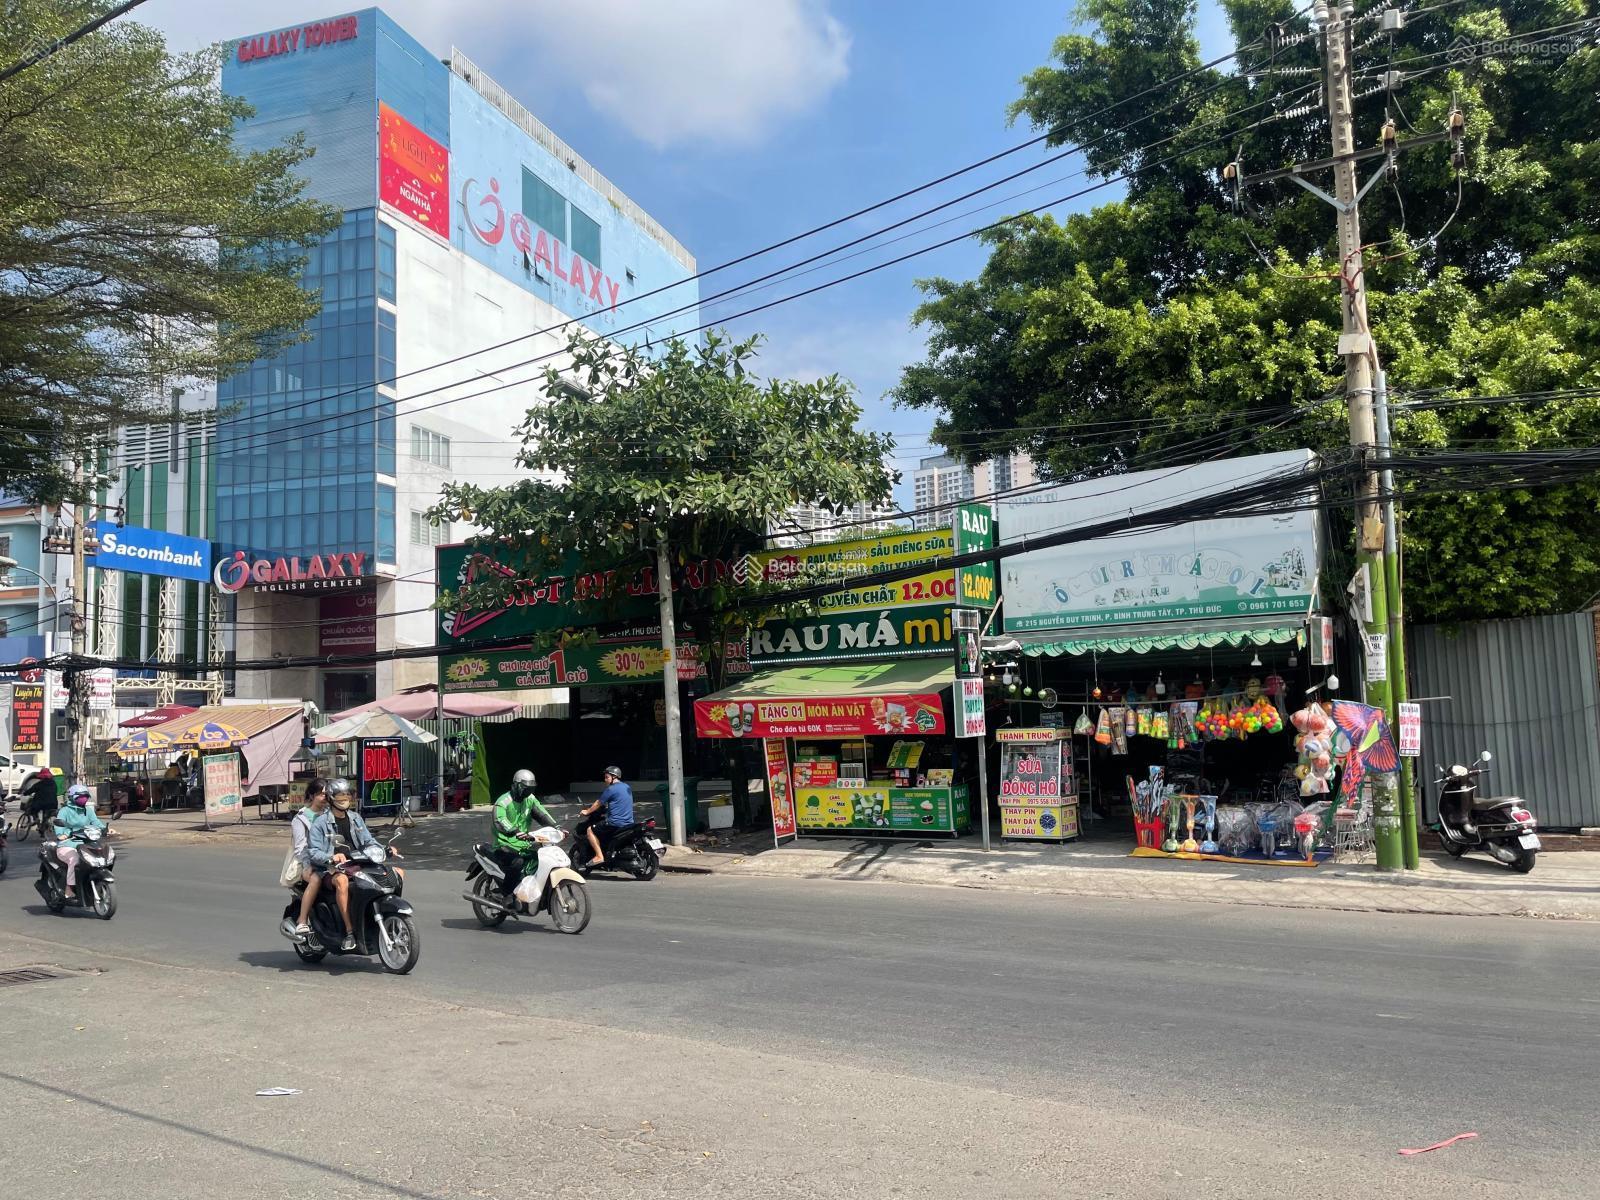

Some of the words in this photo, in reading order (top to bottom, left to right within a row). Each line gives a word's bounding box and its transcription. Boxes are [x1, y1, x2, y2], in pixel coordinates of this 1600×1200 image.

[238, 28, 300, 63] GALAXY
[303, 15, 358, 49] TOWER
[510, 213, 620, 314] GALAXY
[962, 510, 989, 535] RAU
[101, 533, 203, 567] Sacombank
[892, 538, 922, 555] RIÊNG
[252, 552, 366, 583] GALAXY
[254, 582, 306, 593] ENGLISH
[313, 578, 363, 589] CENTER
[1250, 602, 1269, 610] 0961
[1272, 601, 1286, 609] 701
[1288, 599, 1305, 608] 653
[1066, 616, 1080, 624] DUY
[1175, 608, 1188, 616] TP.
[750, 623, 832, 655] RAU
[837, 610, 900, 650] MÁ
[902, 607, 953, 645] mi
[499, 661, 520, 673] CHƠI
[549, 650, 566, 684] 1
[566, 665, 588, 683] GIỜ
[760, 704, 789, 722] TẶNG
[791, 704, 803, 718] 01
[807, 702, 831, 718] MÓN
[847, 701, 866, 720] VẶT
[183, 731, 199, 739] be
[203, 729, 223, 739] be
[769, 724, 783, 733] Cho
[807, 723, 822, 733] 60K
[999, 732, 1024, 741] THANH
[1026, 731, 1053, 740] TRUNG
[363, 748, 401, 782] BIDA
[370, 781, 396, 805] 4T
[1002, 775, 1036, 796] ĐỒNG
[1038, 775, 1057, 795] HỒ
[1006, 827, 1020, 835] LAU
